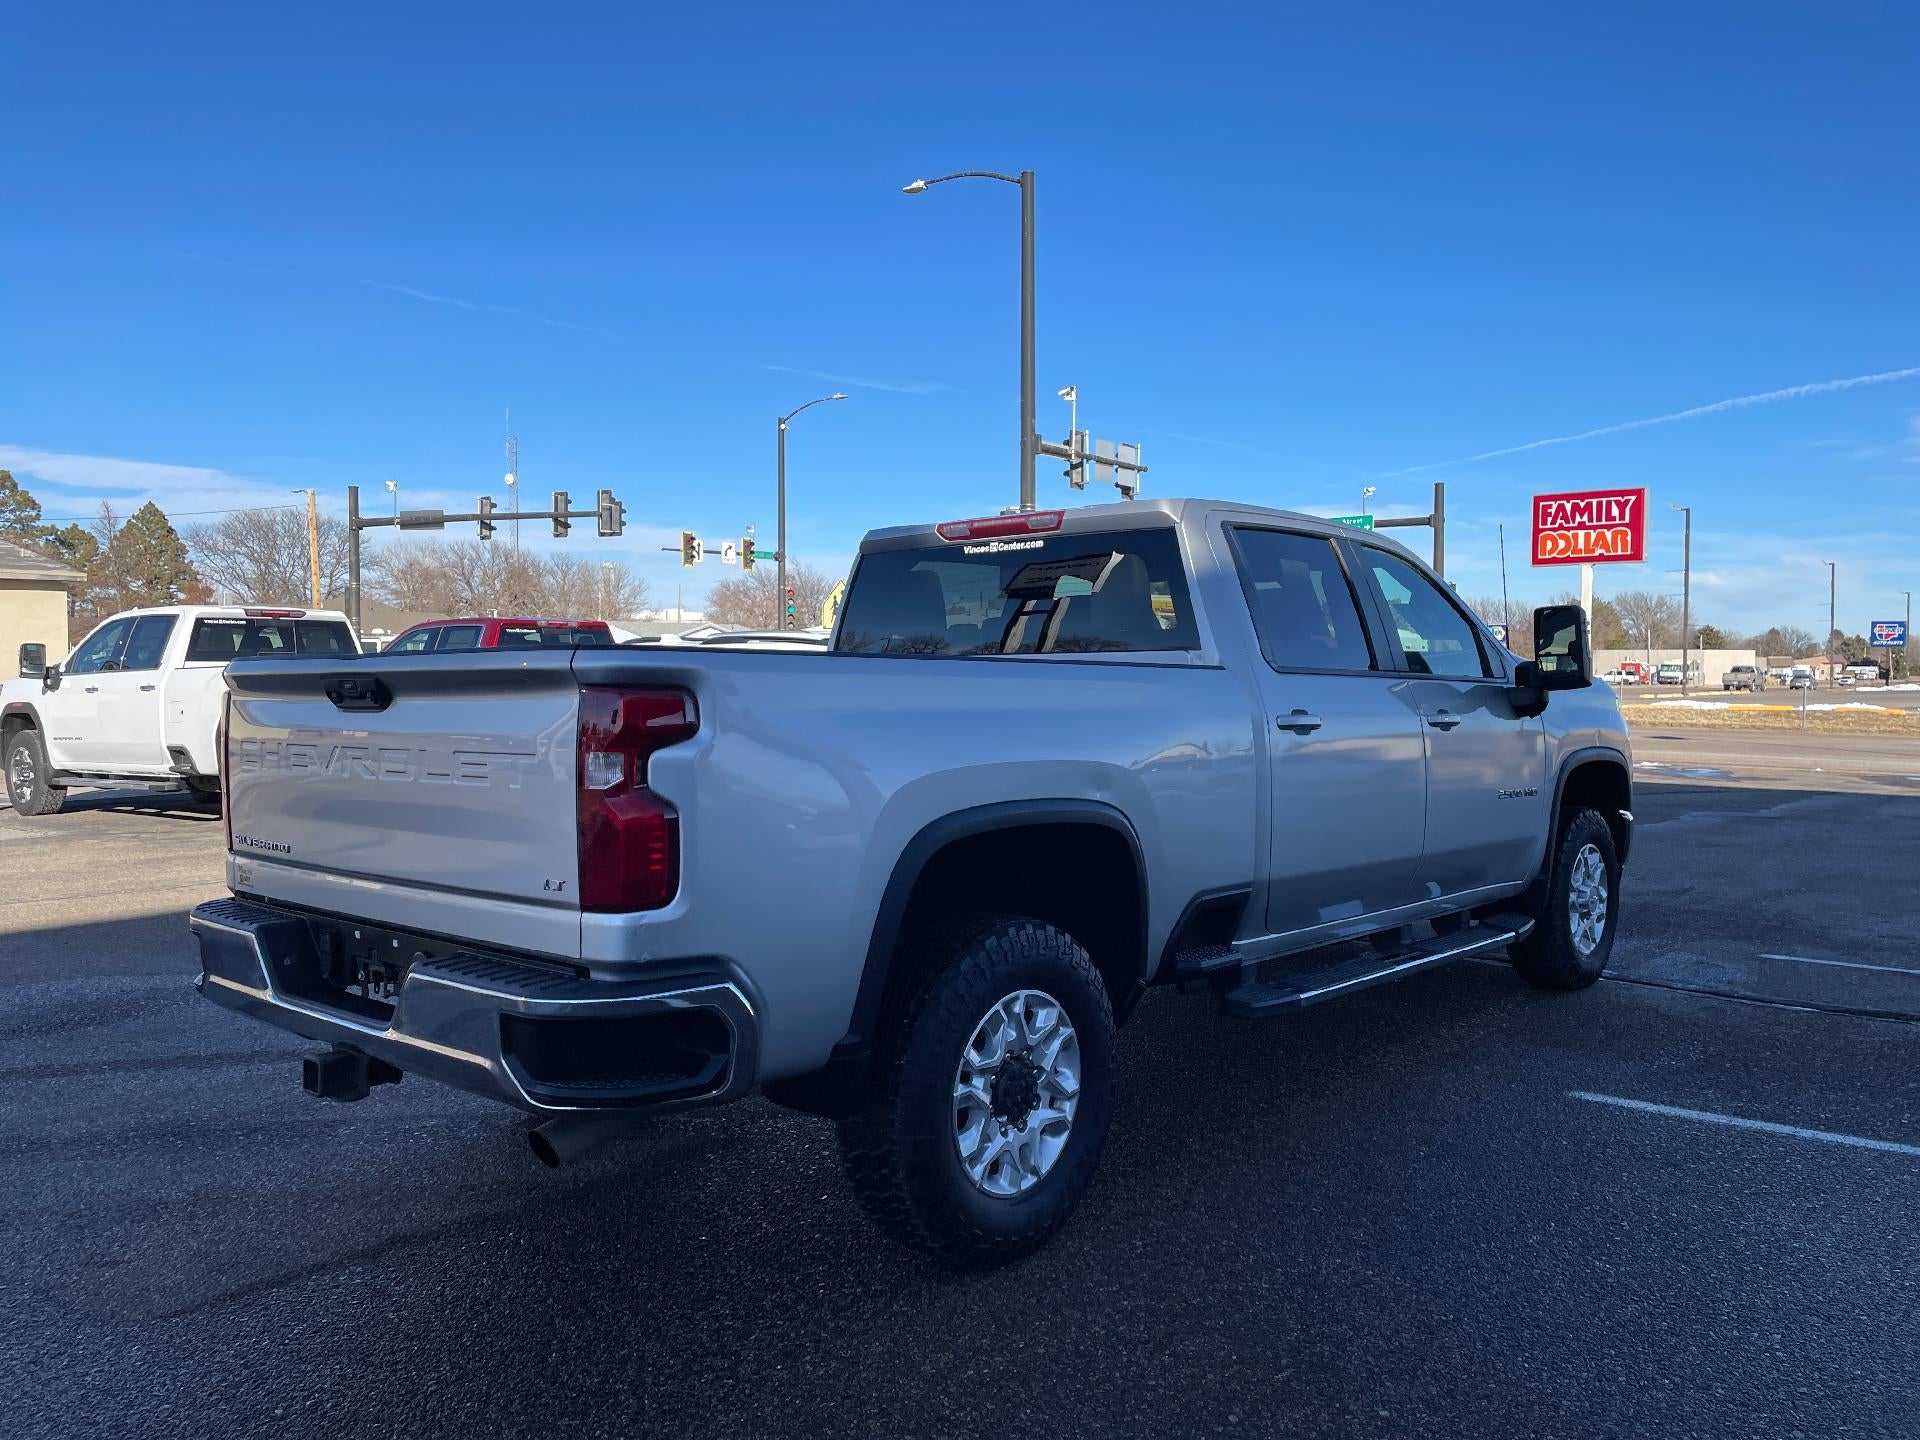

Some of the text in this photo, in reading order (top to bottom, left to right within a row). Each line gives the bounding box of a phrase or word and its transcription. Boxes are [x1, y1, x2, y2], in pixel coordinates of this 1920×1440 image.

[1539, 496, 1637, 528] FAMILY
[1537, 527, 1632, 559] DOLLAR
[240, 740, 538, 789] CHEVROLET
[235, 834, 291, 854] SILVERADO
